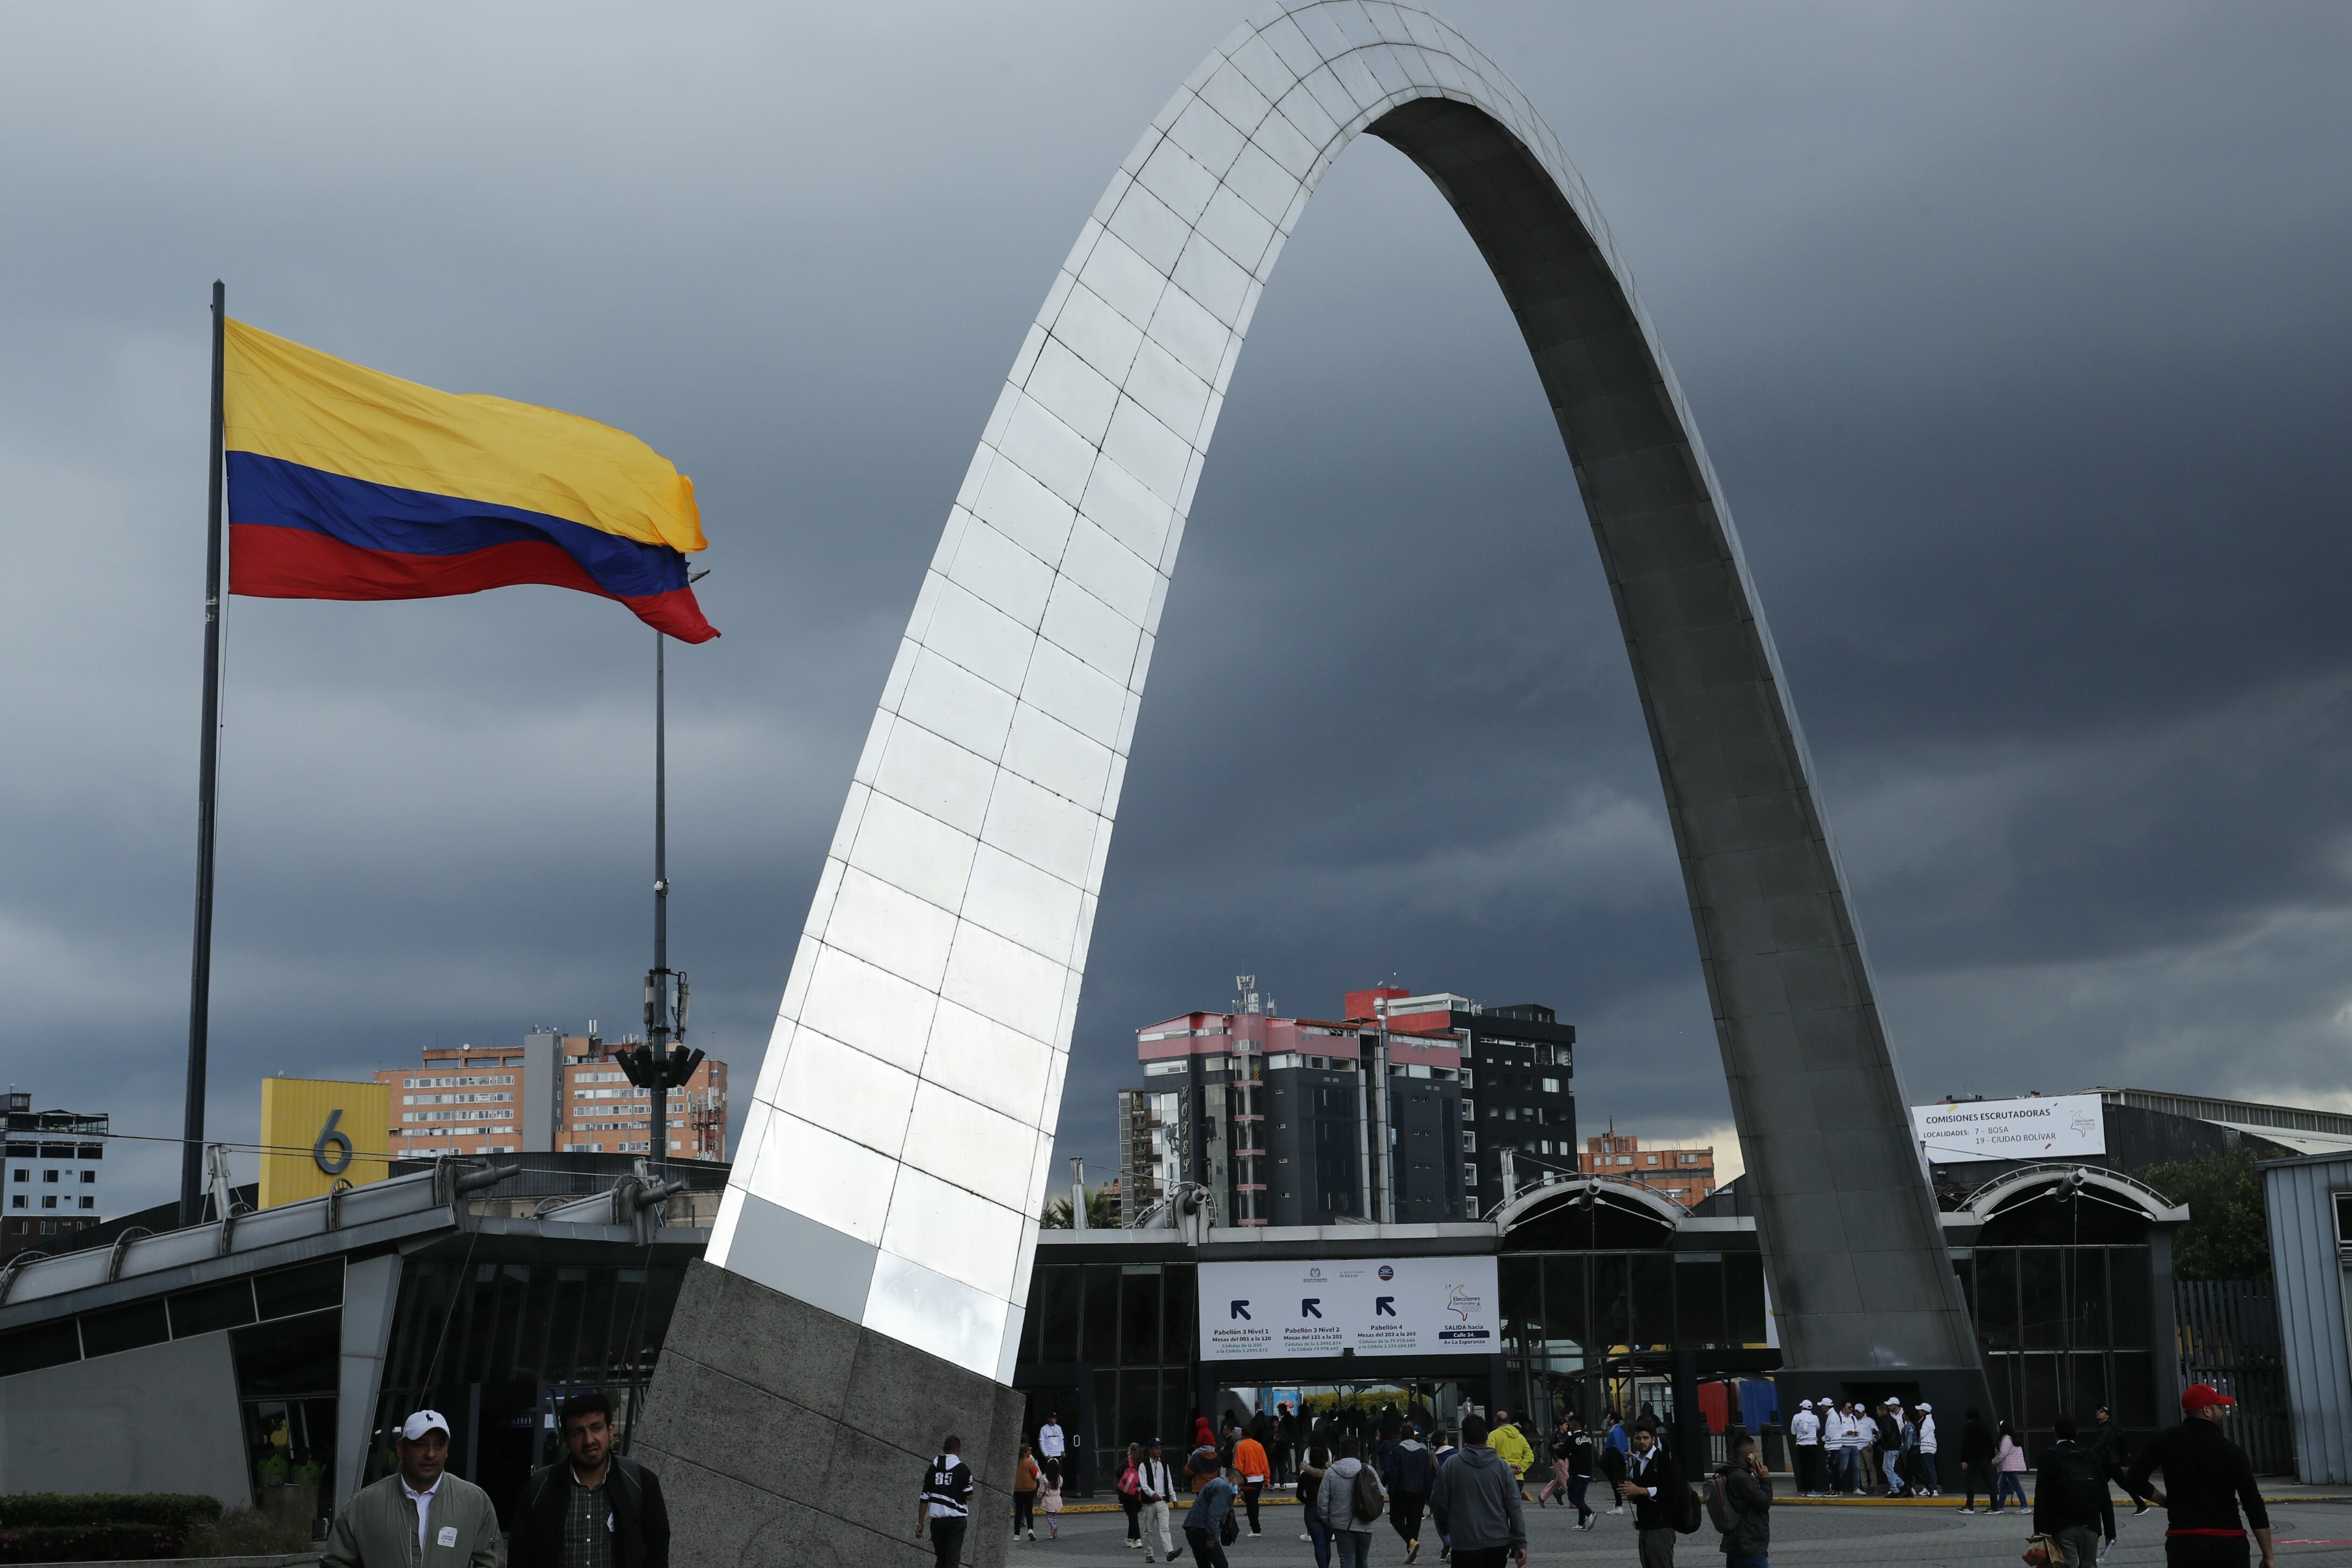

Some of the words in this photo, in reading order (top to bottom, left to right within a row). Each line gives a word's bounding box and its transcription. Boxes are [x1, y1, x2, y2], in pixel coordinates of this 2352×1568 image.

[1926, 1114, 1978, 1124] COMISIONES
[1981, 1109, 2050, 1120] ESCRUTADORAS
[1181, 1085, 1190, 1173] HOTEL
[1923, 1130, 1969, 1138] LOCALIDADES:
[314, 1109, 352, 1175] 6
[1992, 1135, 2021, 1143] CIUDAD
[2024, 1132, 2056, 1141] BOLÍVAR
[935, 1472, 953, 1485] 85
